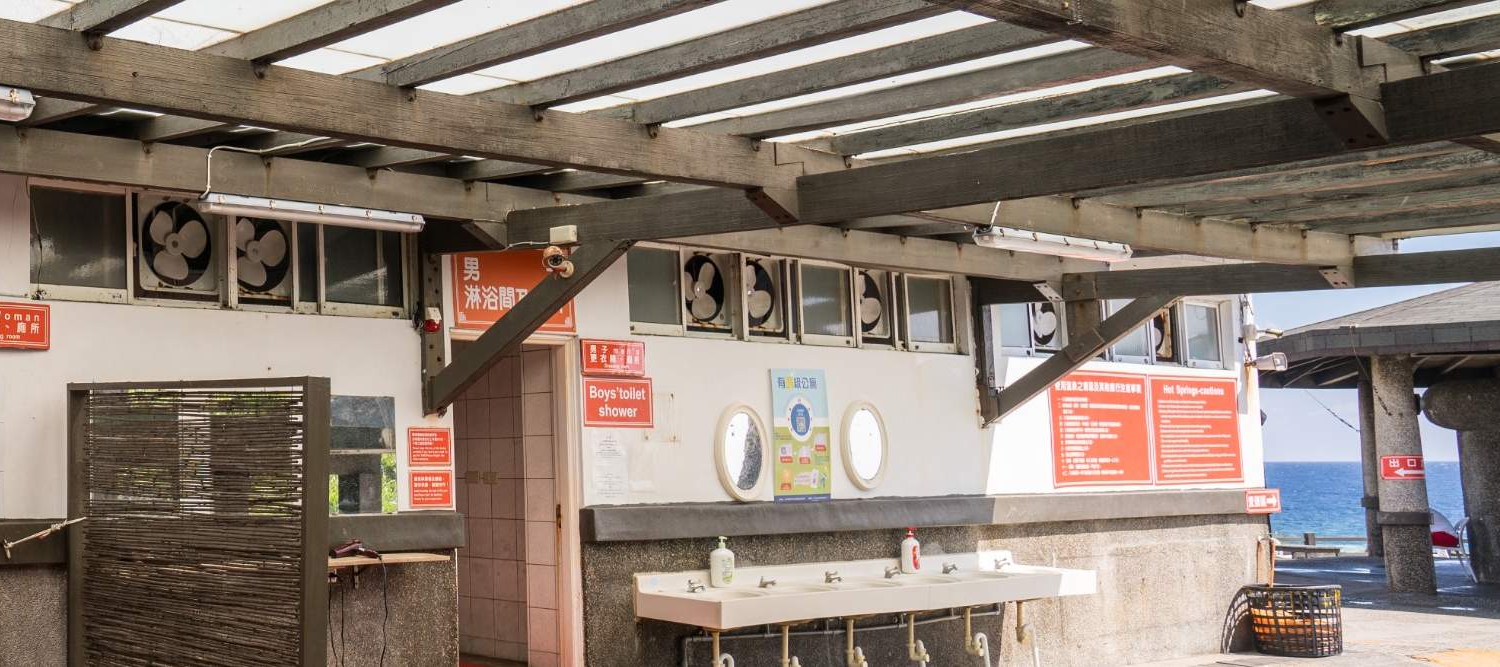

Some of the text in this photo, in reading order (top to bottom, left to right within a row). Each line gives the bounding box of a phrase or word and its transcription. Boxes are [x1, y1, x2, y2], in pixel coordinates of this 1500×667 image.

[464, 256, 480, 281] 男
[1163, 384, 1174, 394] Hot
[598, 403, 638, 417] shower
[1389, 458, 1417, 468] 出口
